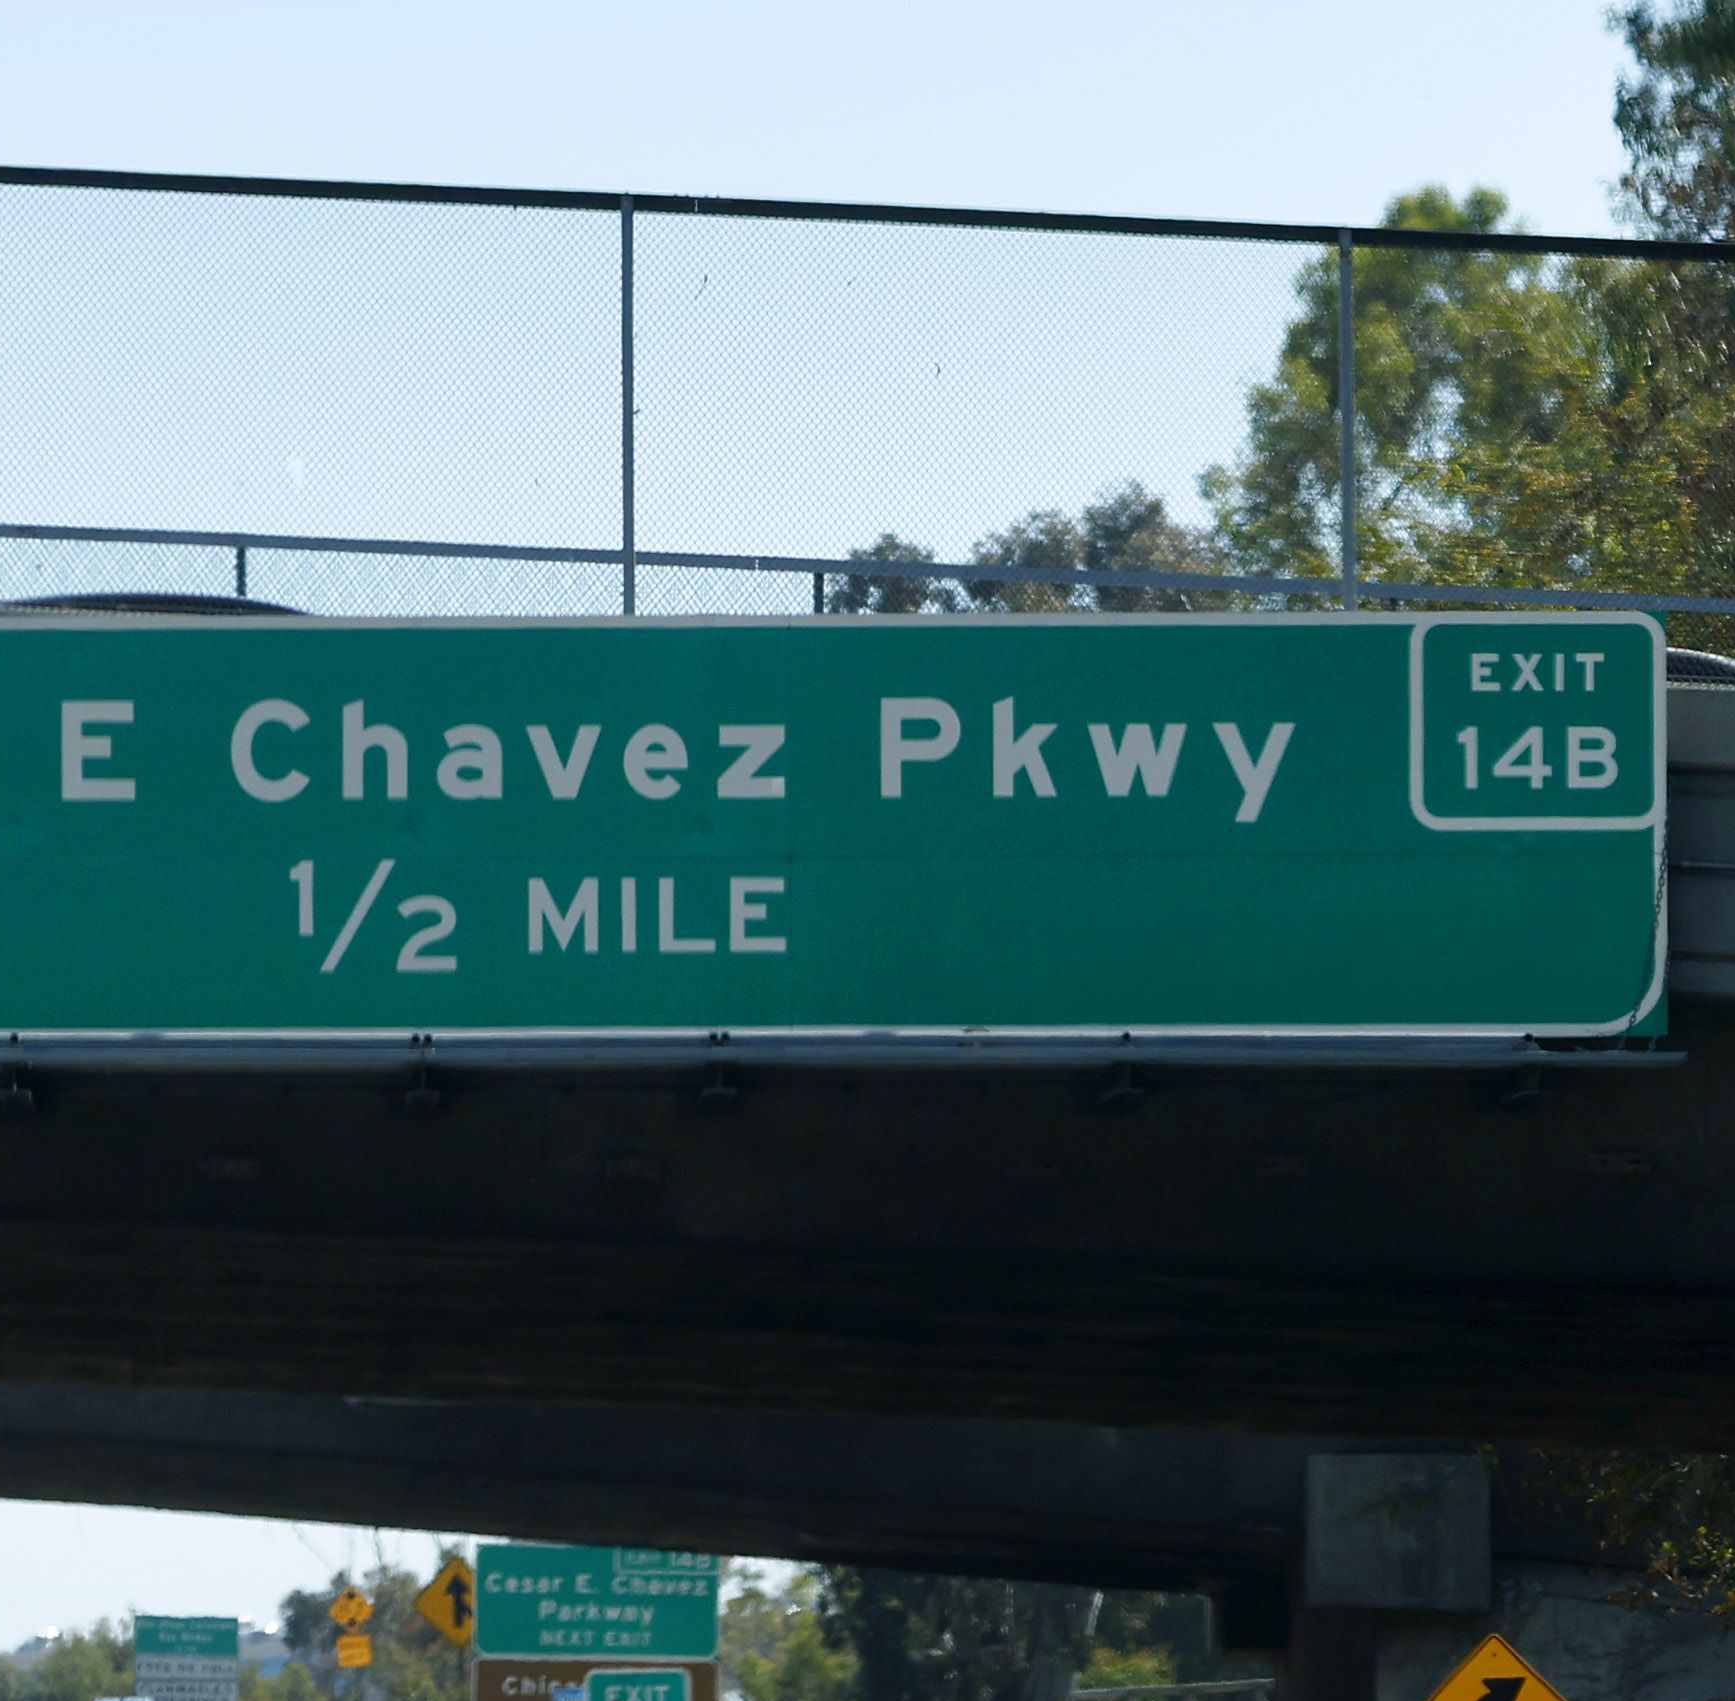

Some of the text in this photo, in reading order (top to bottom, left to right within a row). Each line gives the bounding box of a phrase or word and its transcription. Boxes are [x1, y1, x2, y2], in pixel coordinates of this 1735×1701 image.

[1471, 653, 1605, 692] EXIT
[62, 700, 137, 800] E
[230, 698, 786, 803] Chavez
[879, 696, 1296, 823] Pkwy
[1457, 725, 1619, 790] 14B
[289, 858, 788, 973] 1/2 MILE
[484, 1572, 564, 1593] Cesar
[612, 1575, 710, 1596] Chavez
[537, 1600, 655, 1625] Parkway
[604, 1632, 653, 1647] EXIT
